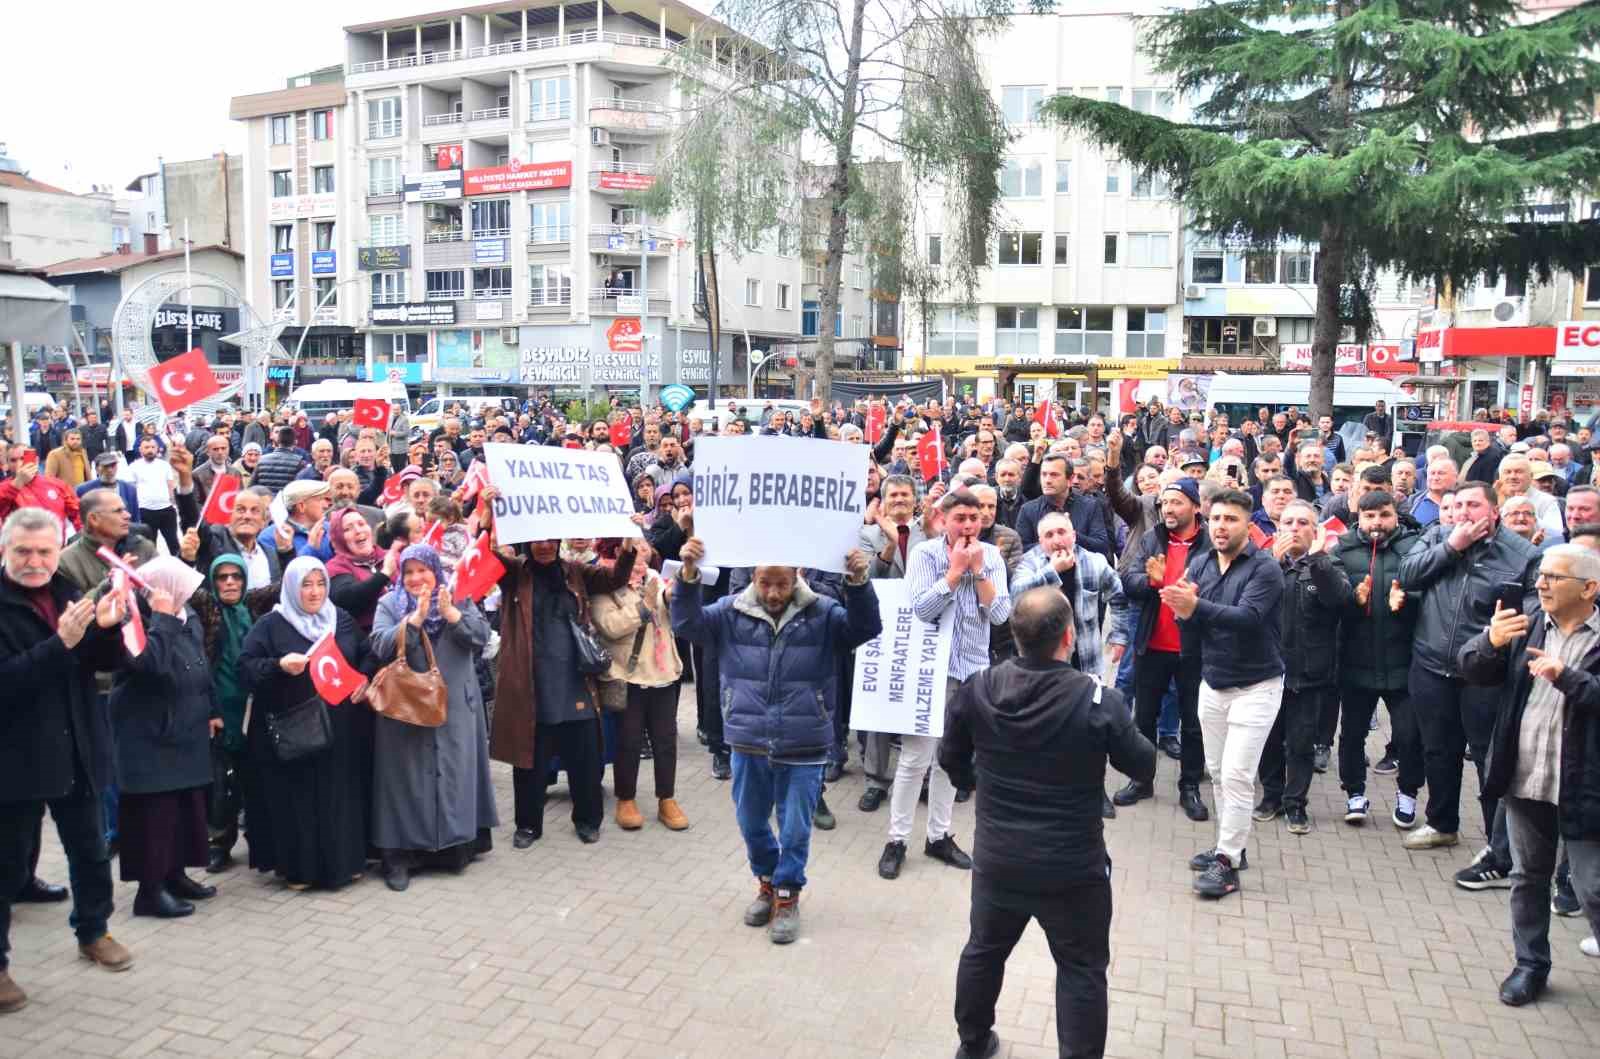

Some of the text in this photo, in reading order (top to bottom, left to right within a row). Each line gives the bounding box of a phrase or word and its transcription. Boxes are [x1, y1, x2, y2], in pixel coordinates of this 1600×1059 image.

[195, 313, 222, 331] CAFE
[505, 459, 609, 487] YALNIZ TAŞ
[695, 464, 860, 513] BİRİZ, BERABERİZ.
[495, 495, 562, 517] DUVAR
[861, 635, 885, 692] EVCİ ŞA
[888, 607, 913, 703] MENFAATLERE
[914, 667, 934, 734] MALZEME
